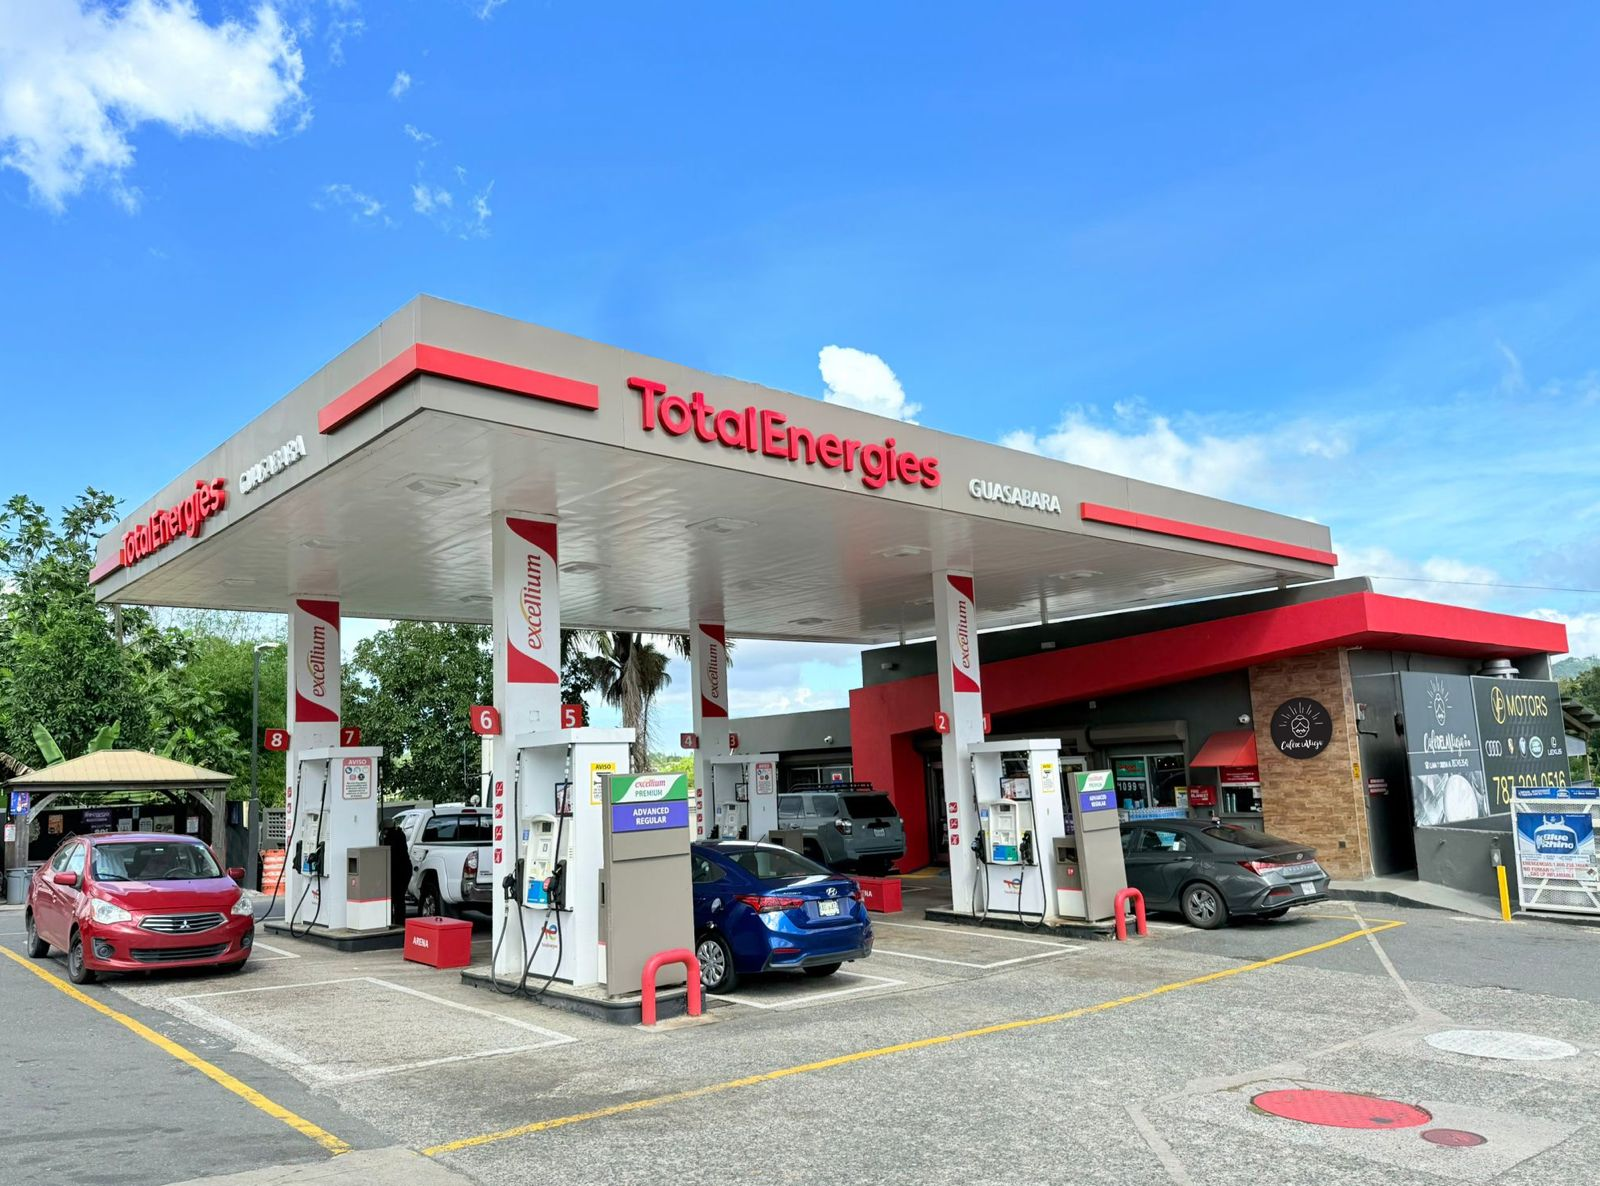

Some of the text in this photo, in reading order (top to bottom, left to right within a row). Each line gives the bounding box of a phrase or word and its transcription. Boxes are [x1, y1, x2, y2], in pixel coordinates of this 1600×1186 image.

[627, 377, 941, 489] TotalEnergies
[969, 479, 1062, 514] GUASABARA
[121, 478, 225, 567] TotalEnergies
[522, 553, 542, 650] excellium
[958, 600, 970, 669] excellium
[309, 625, 325, 697] excellium
[707, 643, 718, 699] excellium
[1505, 694, 1548, 717] MOTORS
[480, 710, 493, 729] 6
[565, 709, 576, 727] 5
[938, 715, 946, 730] 2
[271, 733, 283, 747] 8
[345, 730, 354, 744] 7
[684, 735, 693, 747] 4
[730, 735, 736, 746] 3
[633, 806, 670, 816] ADVANCED
[635, 816, 667, 825] REGULAR
[1543, 833, 1569, 842] Blue
[412, 936, 429, 948] ARENA
